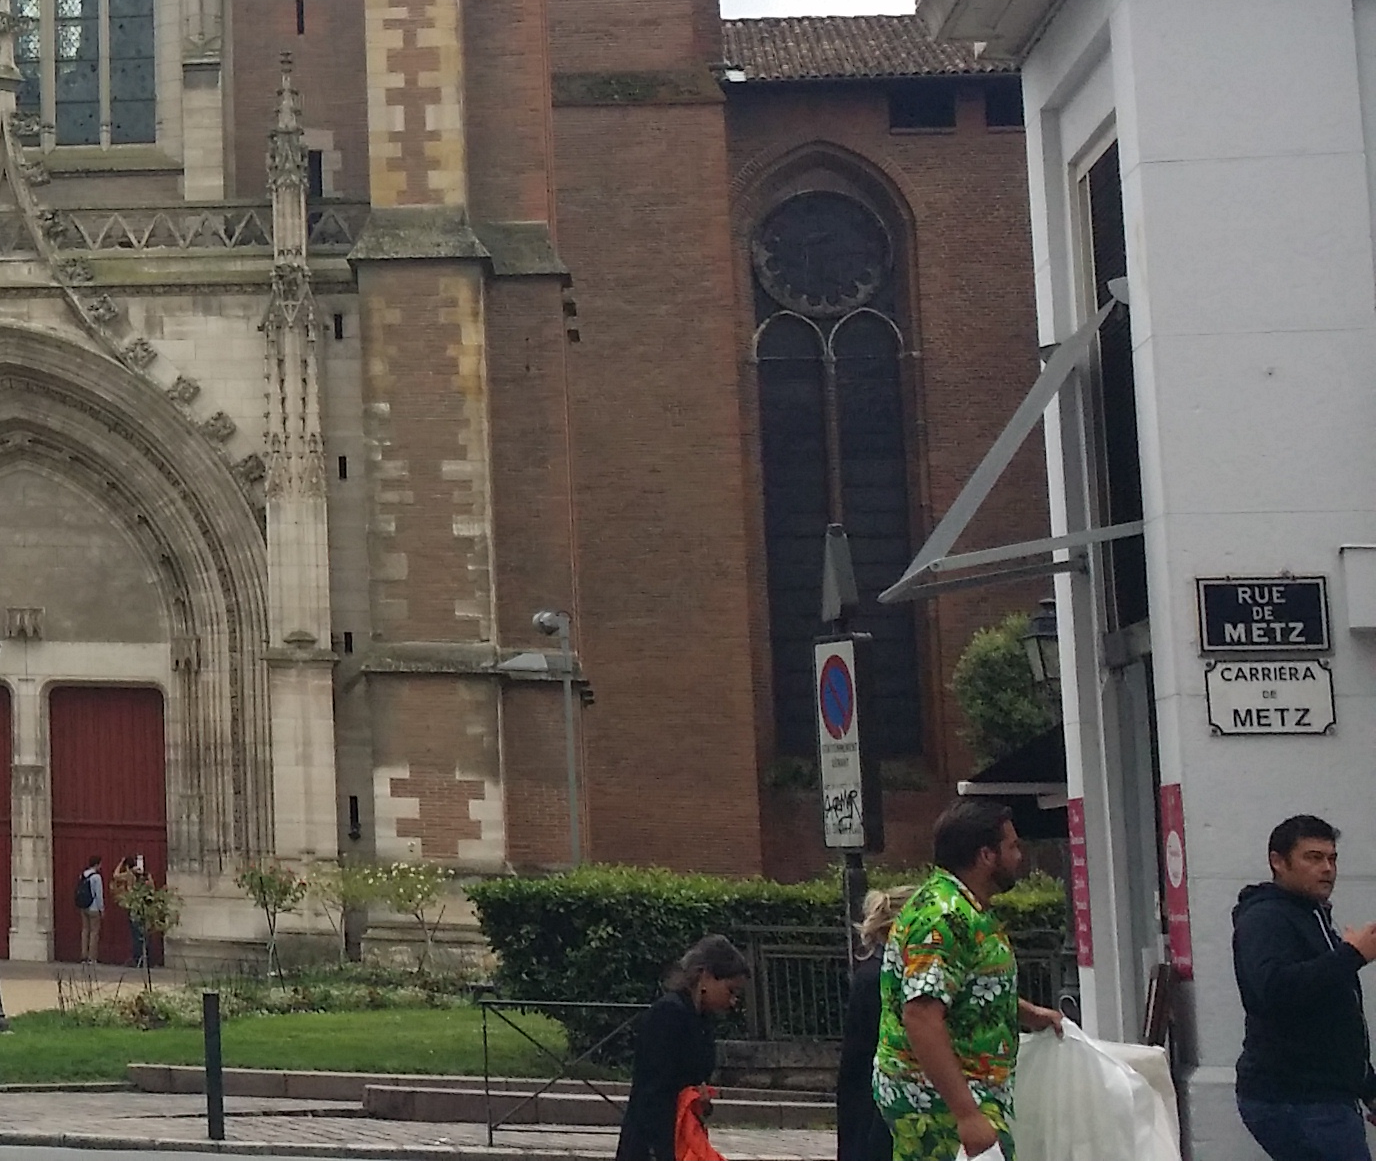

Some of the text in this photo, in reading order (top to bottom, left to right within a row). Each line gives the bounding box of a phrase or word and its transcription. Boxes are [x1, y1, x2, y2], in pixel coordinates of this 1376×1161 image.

[1237, 586, 1287, 604] RUE
[1252, 606, 1274, 620] DE
[1223, 622, 1306, 643] METZ
[1262, 690, 1277, 699] DE
[1233, 708, 1311, 727] METZ
